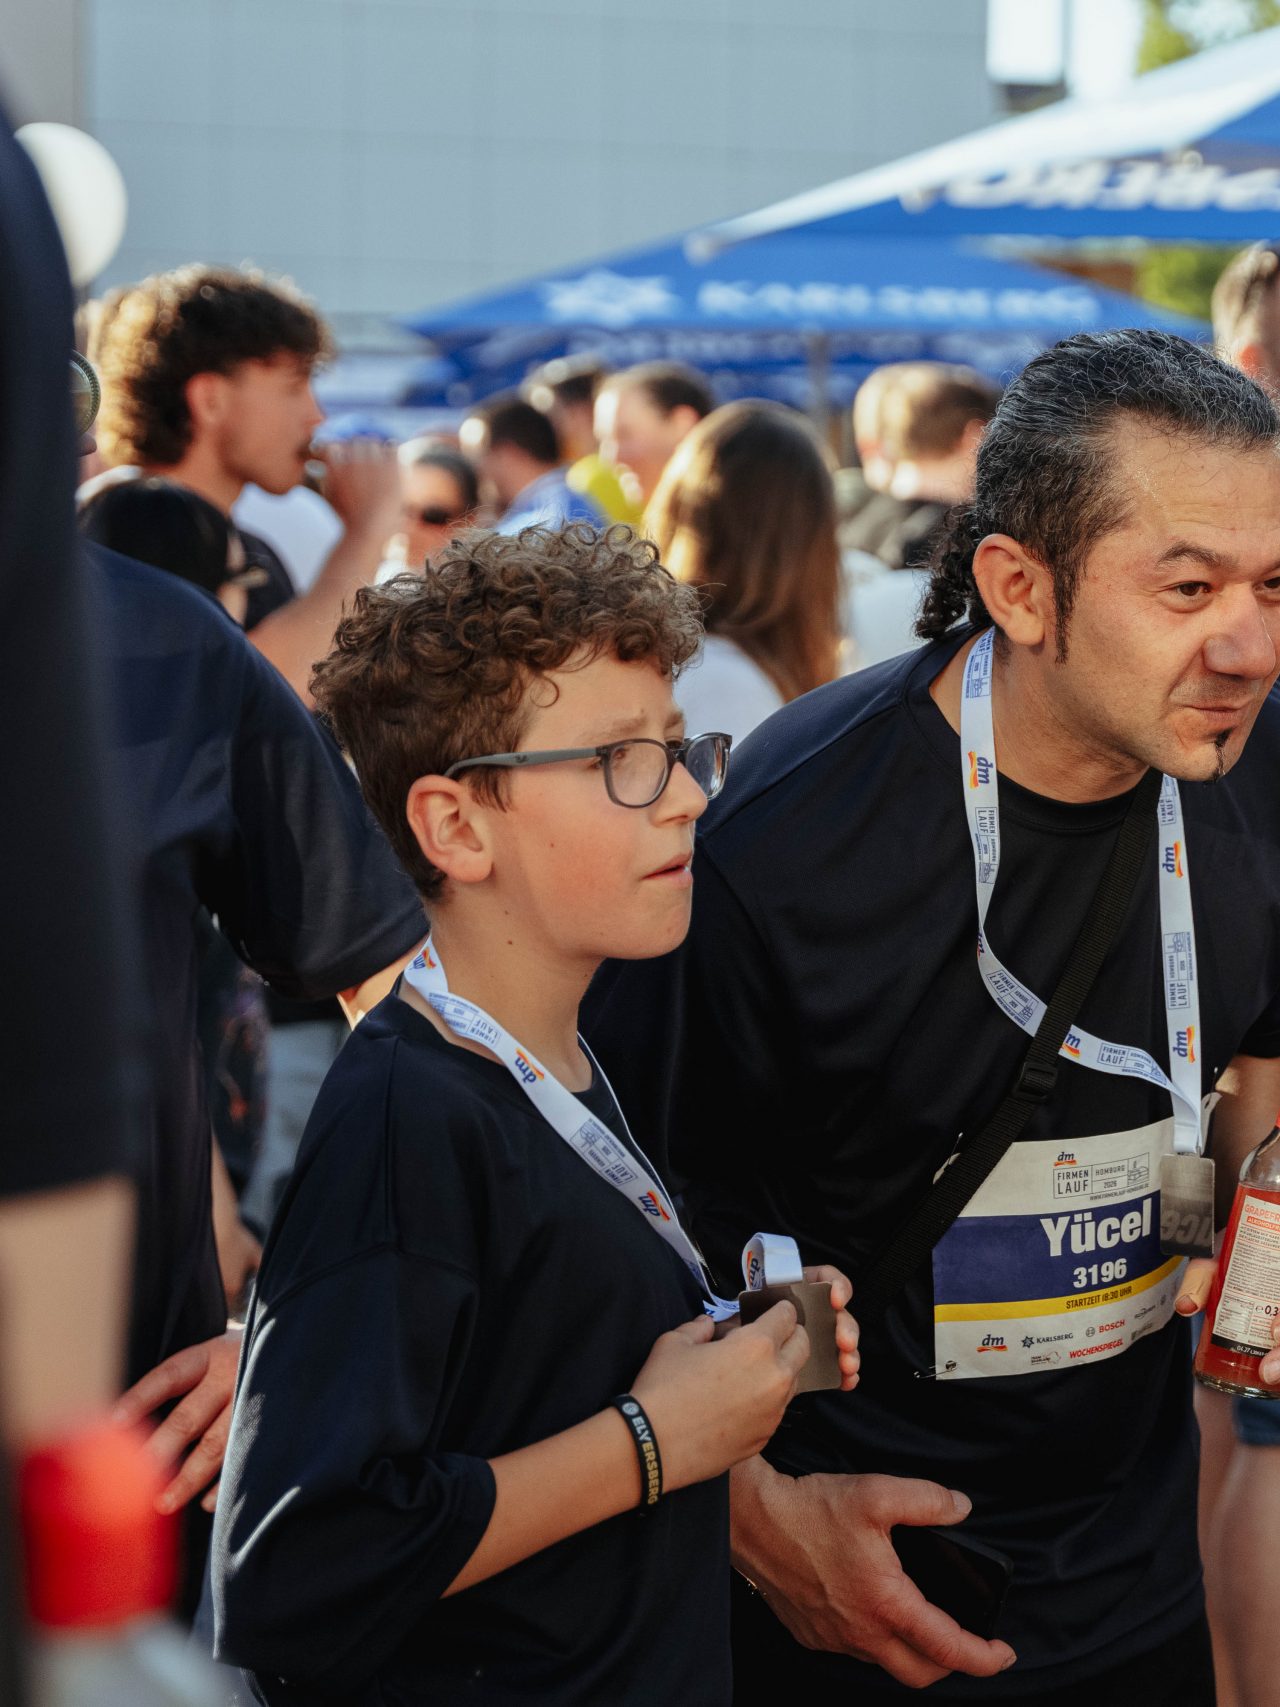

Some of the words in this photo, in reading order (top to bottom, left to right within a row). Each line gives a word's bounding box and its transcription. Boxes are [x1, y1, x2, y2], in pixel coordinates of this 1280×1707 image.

[977, 756, 993, 784] dm
[978, 810, 989, 833] LAUF
[1162, 847, 1175, 873] dm
[989, 975, 1009, 994] LAUF
[998, 972, 1016, 990] FIRMEN
[1169, 983, 1177, 1007] FIRMEN
[1177, 982, 1188, 1006] LAUF
[1065, 1033, 1081, 1049] m
[1103, 1046, 1126, 1055] FIRMEN
[1173, 1031, 1188, 1058] dm
[1101, 1053, 1124, 1064] LAUF
[514, 1056, 537, 1083] dm
[1057, 1151, 1075, 1161] dm
[611, 1163, 633, 1180] LAUF
[1057, 1170, 1089, 1180] FIRMEN
[1096, 1165, 1125, 1176] HOMBURG
[1057, 1180, 1089, 1194] LAUF
[638, 1195, 660, 1216] dm
[1040, 1198, 1152, 1257] Yücel
[1073, 1258, 1127, 1288] 3196
[1066, 1294, 1100, 1309] STARTZEIT
[1102, 1290, 1119, 1303] 18:30
[1119, 1286, 1132, 1299] UHR
[1099, 1320, 1125, 1333] BOSCH
[982, 1334, 1004, 1346] dm
[1036, 1333, 1073, 1344] KARLSBERG
[1069, 1339, 1124, 1359] WOCHENSPIEGEL
[632, 1416, 659, 1505] ELVERSBERG
